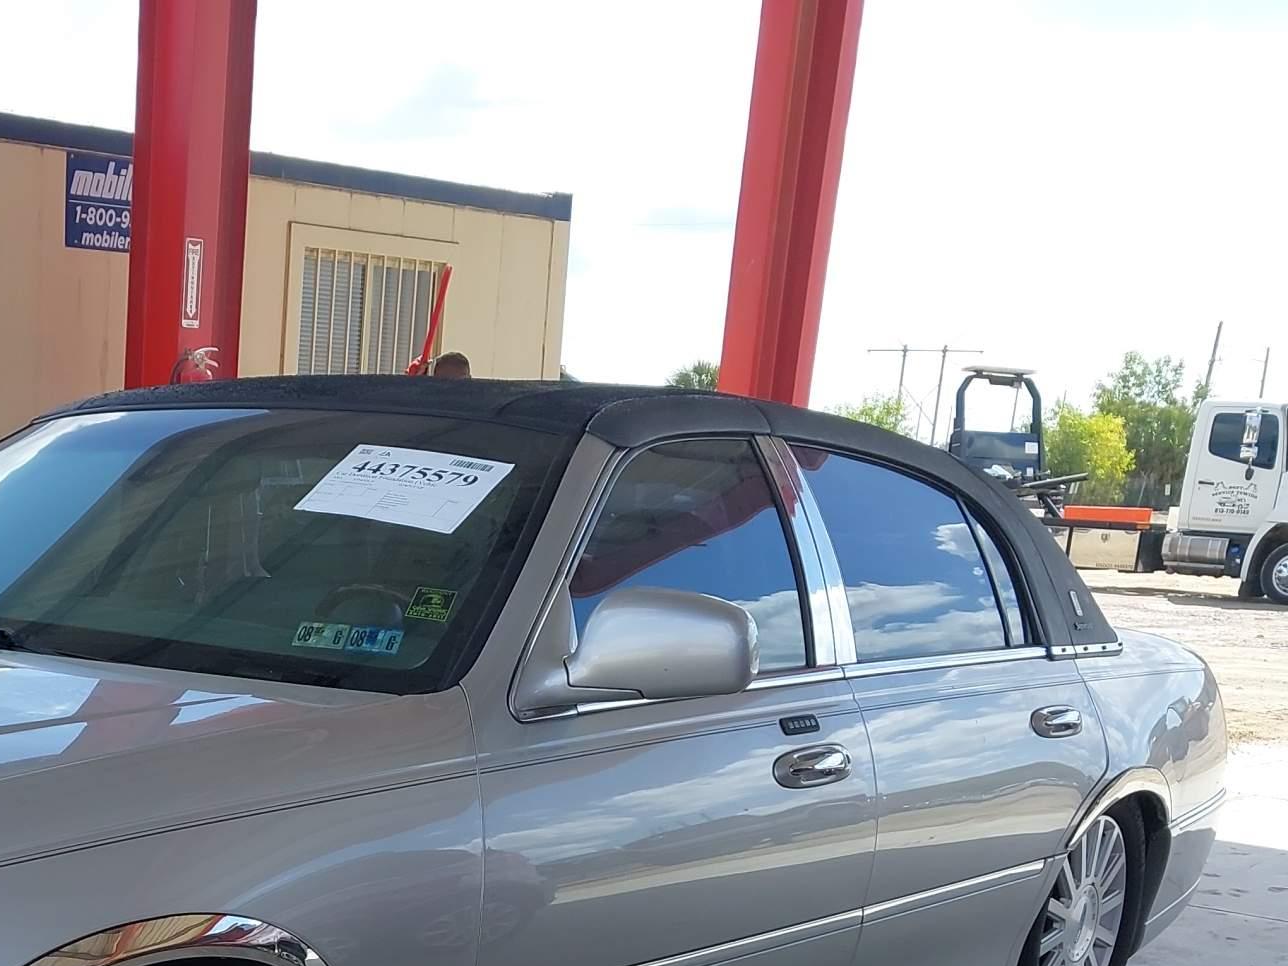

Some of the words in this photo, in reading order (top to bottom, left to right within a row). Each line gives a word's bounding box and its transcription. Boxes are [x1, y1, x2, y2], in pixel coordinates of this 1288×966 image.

[70, 161, 133, 202] mobil
[75, 205, 131, 229] 1-800-9
[352, 460, 479, 487] 44375579
[297, 625, 314, 642] 08
[350, 630, 367, 647] 08
